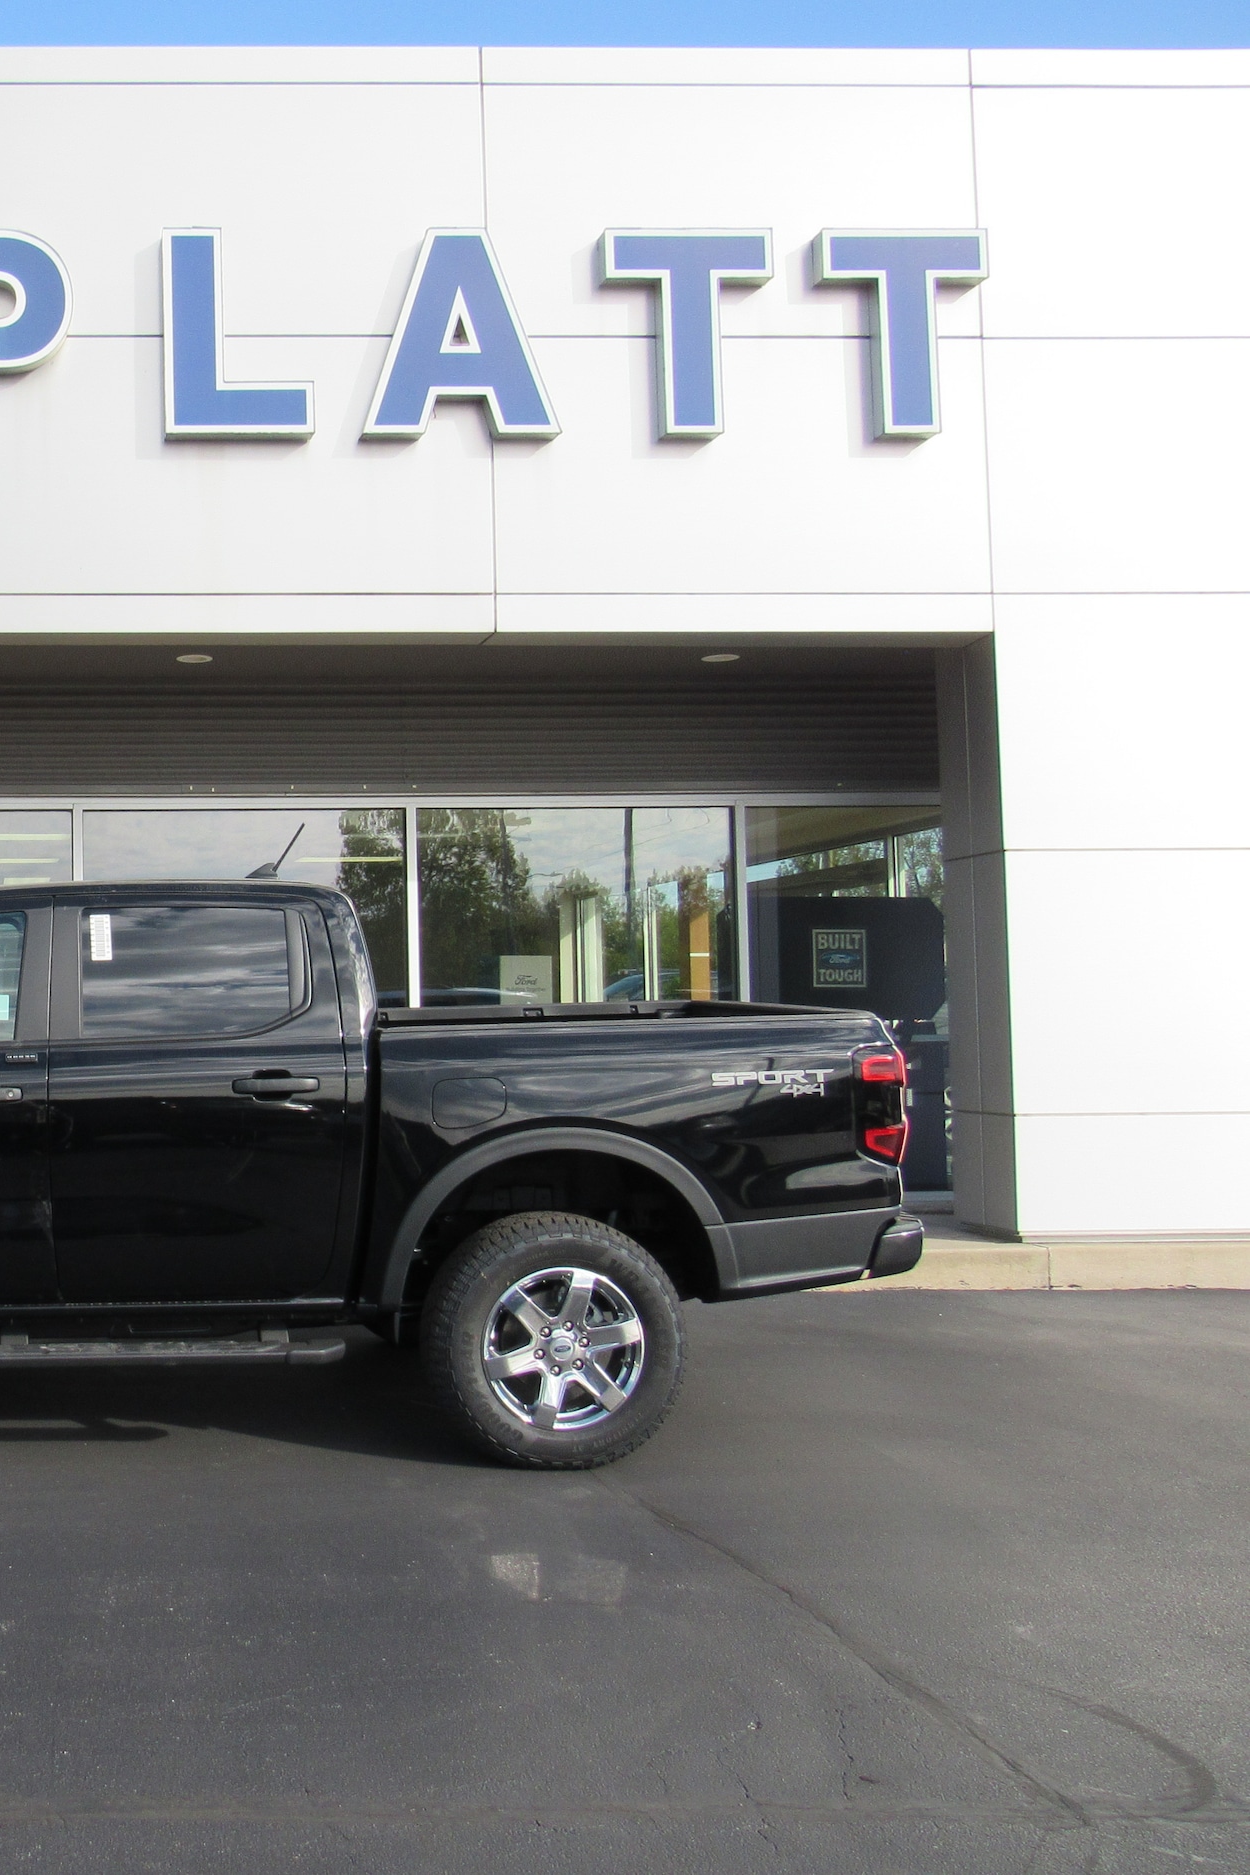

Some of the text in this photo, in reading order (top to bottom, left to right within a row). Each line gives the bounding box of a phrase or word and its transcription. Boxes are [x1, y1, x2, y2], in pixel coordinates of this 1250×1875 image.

[817, 933, 861, 950] BUILT
[514, 974, 538, 986] Ford
[818, 968, 862, 982] TOUGH
[711, 1068, 834, 1087] SPORT
